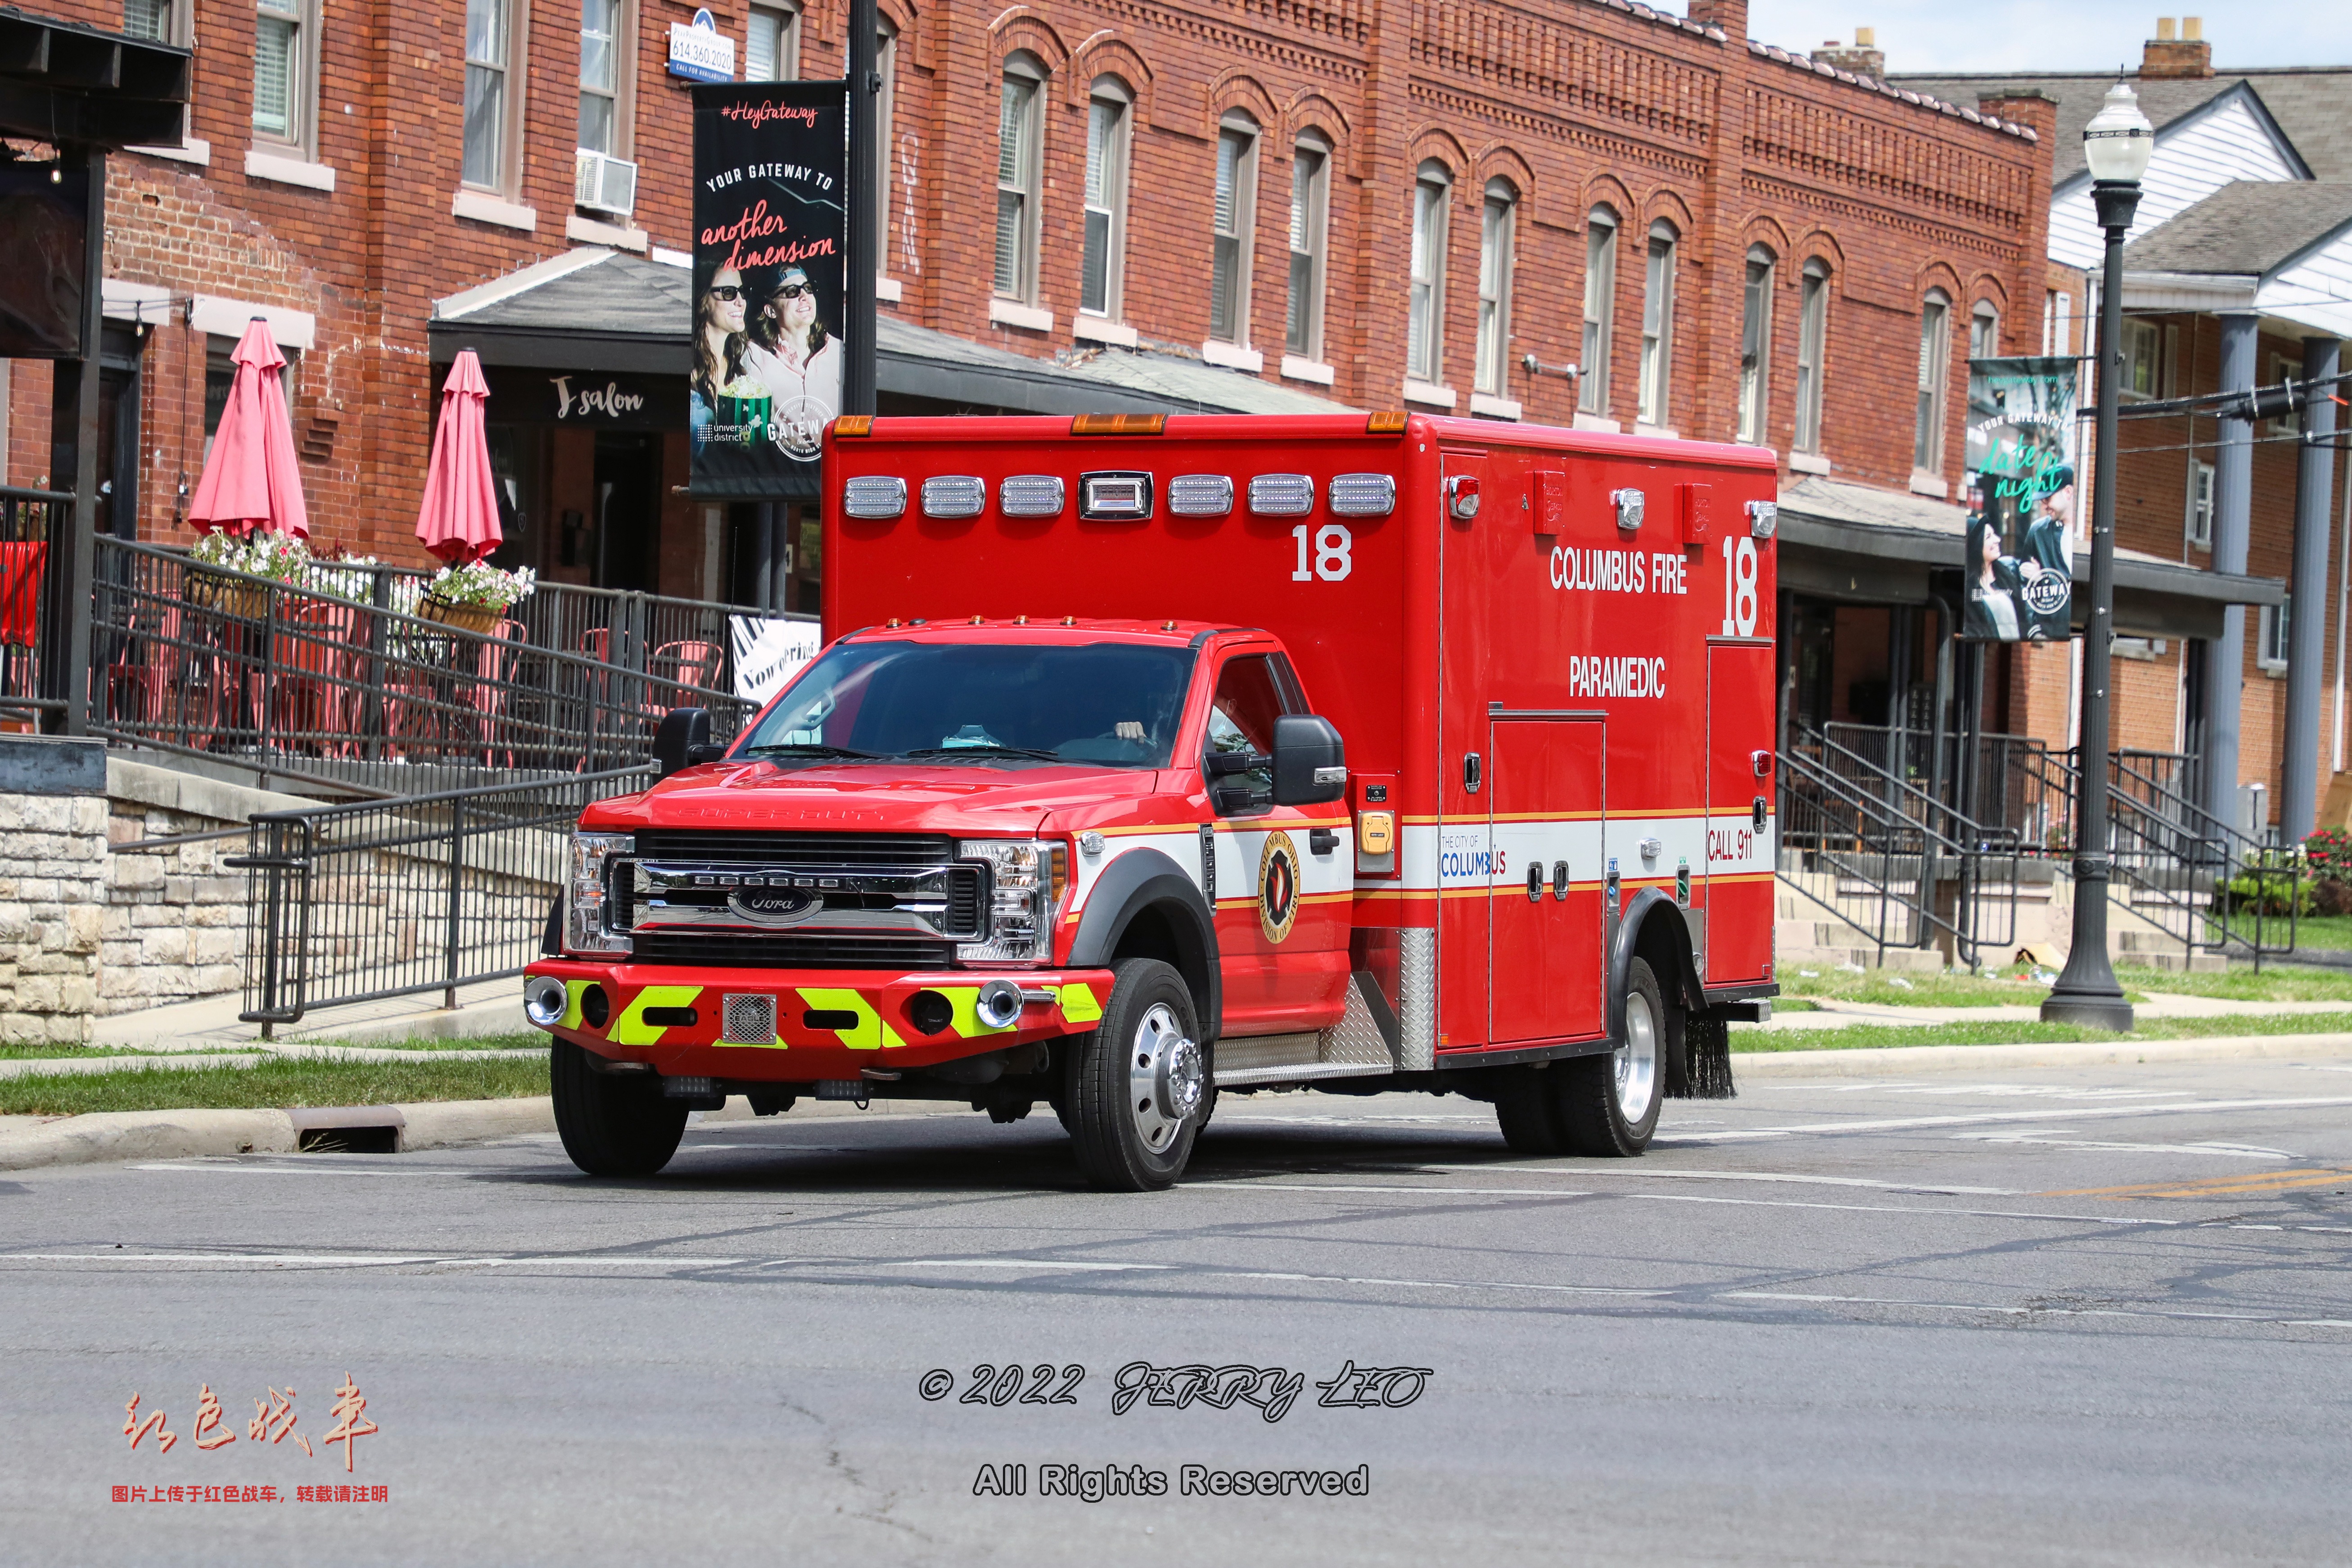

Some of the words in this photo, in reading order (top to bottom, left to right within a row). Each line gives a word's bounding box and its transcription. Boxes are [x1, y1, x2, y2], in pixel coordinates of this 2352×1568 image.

[673, 40, 731, 70] 614.360.2020
[676, 63, 687, 72] CALL
[689, 67, 698, 76] FOR
[699, 69, 727, 82] AVAILABILITY
[721, 100, 818, 129] #HeyGateway
[706, 168, 742, 193] YOUR
[749, 163, 812, 181] GATEWAY
[816, 173, 833, 191] TO
[701, 199, 787, 245] another
[723, 235, 836, 272] dimension
[578, 382, 644, 417] salon
[713, 424, 753, 434] university
[714, 433, 742, 442] district
[767, 417, 835, 441] GATEWA
[1977, 415, 2003, 433] YOUR
[2008, 412, 2054, 426] GATEWAY
[790, 444, 804, 454] NORTH
[1979, 434, 2038, 474] date
[1995, 451, 2063, 514] night
[1292, 525, 1351, 581] 18
[1549, 545, 1646, 594] COLUMBUS
[1652, 553, 1687, 595] FIRE
[1722, 536, 1757, 637] 18
[2022, 581, 2072, 601] GATEWAY
[1569, 655, 1666, 699] PARAMEDIC
[677, 808, 794, 819] SUPER
[800, 810, 884, 821] DUTY
[1442, 836, 1454, 848] THE
[1455, 836, 1469, 848] CITY
[1470, 835, 1478, 848] OF
[1708, 829, 1734, 862] CALL
[1738, 829, 1752, 860] 911
[1261, 833, 1286, 882] COLUMBUS
[1287, 844, 1299, 880] OHIO
[1441, 850, 1506, 877] COLUMBUS
[751, 890, 795, 909] Ford
[1260, 894, 1278, 941] DIVISION
[1280, 924, 1288, 939] OF
[1289, 891, 1298, 924] FIRE
